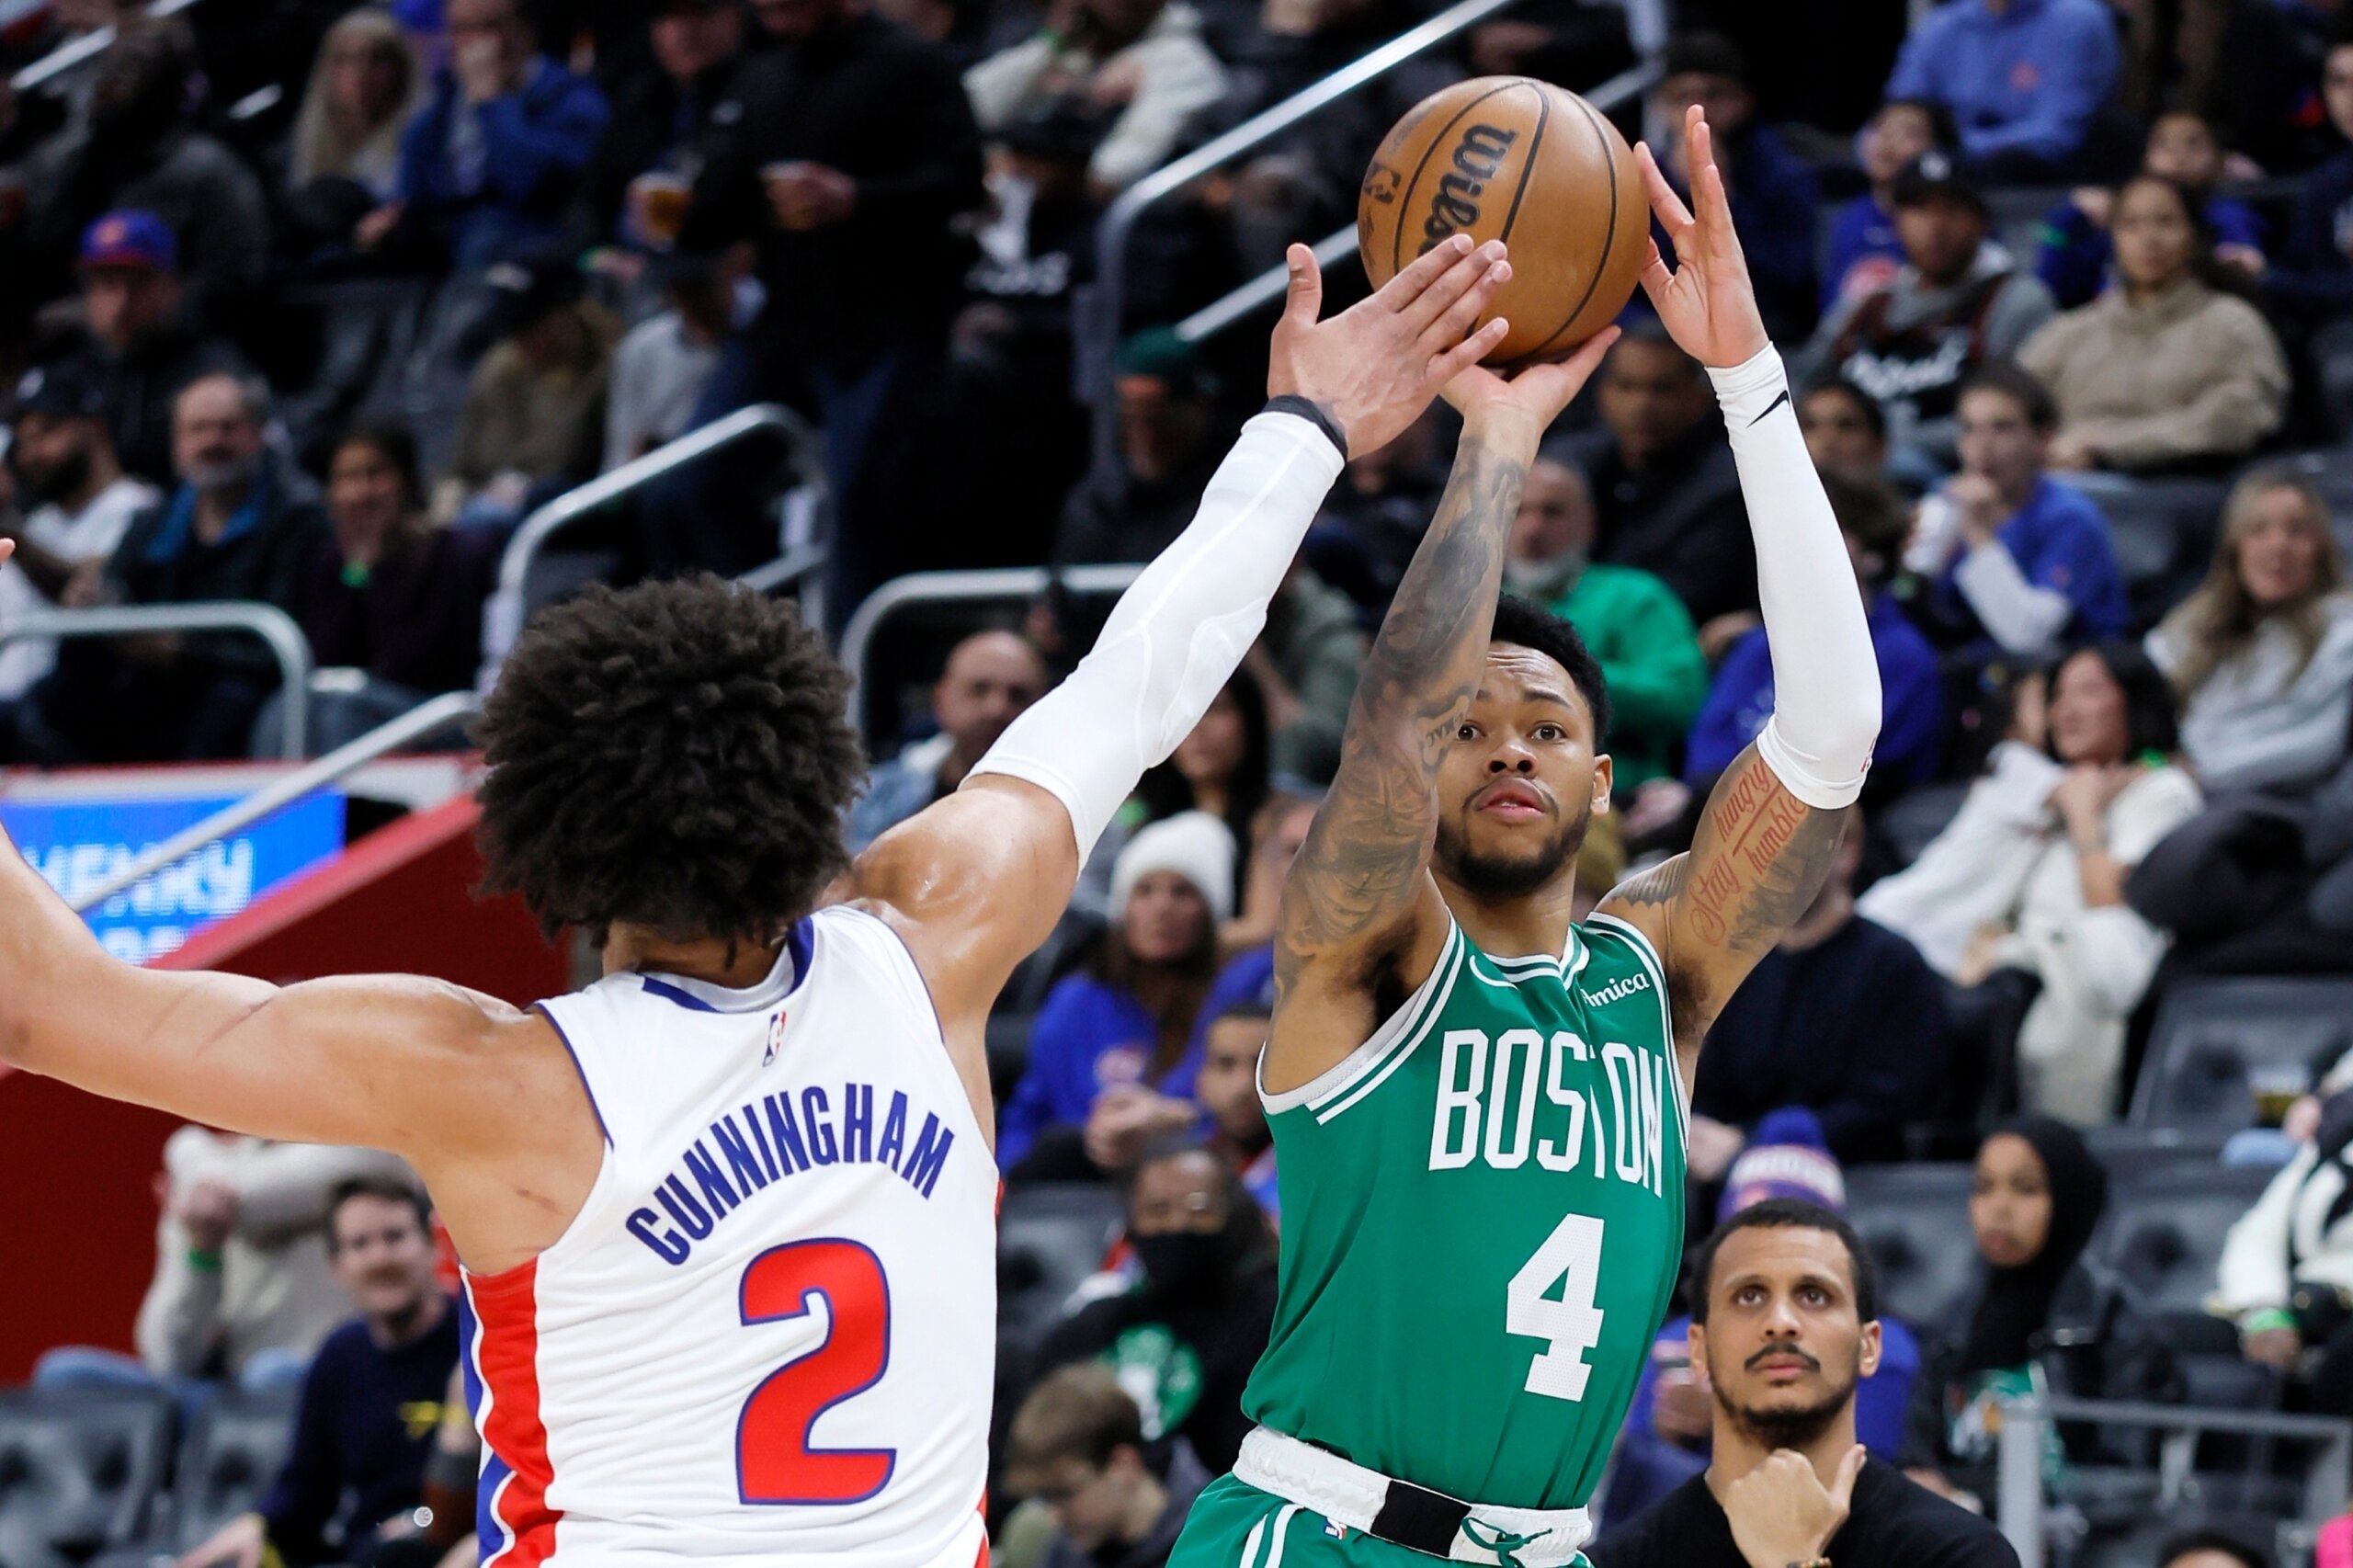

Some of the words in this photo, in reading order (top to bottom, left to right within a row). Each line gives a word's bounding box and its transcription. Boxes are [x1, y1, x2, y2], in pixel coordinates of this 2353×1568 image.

[1417, 123, 1518, 256] Wils
[1712, 756, 1771, 844] hungry
[1744, 793, 1808, 876] humble
[1688, 852, 1742, 948] Stay
[625, 1082, 955, 1266] CUNNINGHAM
[735, 1237, 896, 1506] 2
[1506, 1213, 1605, 1403] 4
